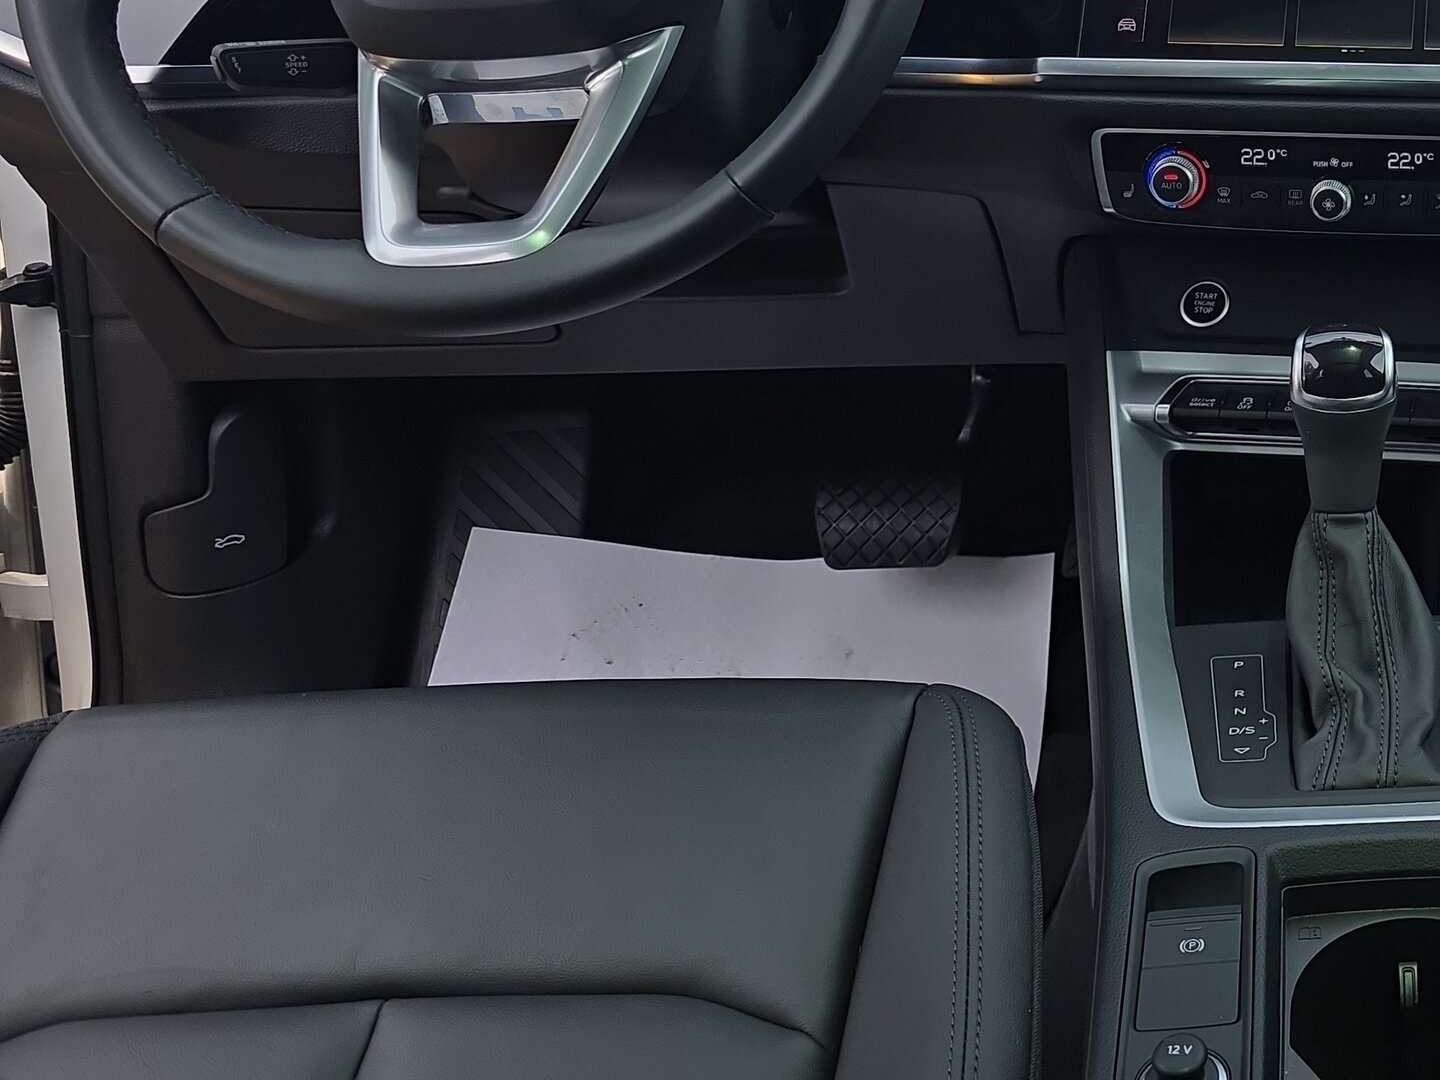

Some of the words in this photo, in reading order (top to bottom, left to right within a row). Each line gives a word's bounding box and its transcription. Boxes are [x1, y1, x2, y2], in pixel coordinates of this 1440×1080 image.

[1312, 160, 1329, 168] PUSH
[1161, 181, 1183, 191] AUTO
[1194, 291, 1218, 300] START
[1194, 306, 1214, 314] STOP
[1236, 402, 1253, 410] OFF
[1233, 661, 1244, 669] P
[1234, 689, 1245, 697] R
[1234, 707, 1246, 715] N
[1228, 726, 1255, 735] D/S
[1167, 1044, 1180, 1056] 12
[1183, 1044, 1193, 1055] V
